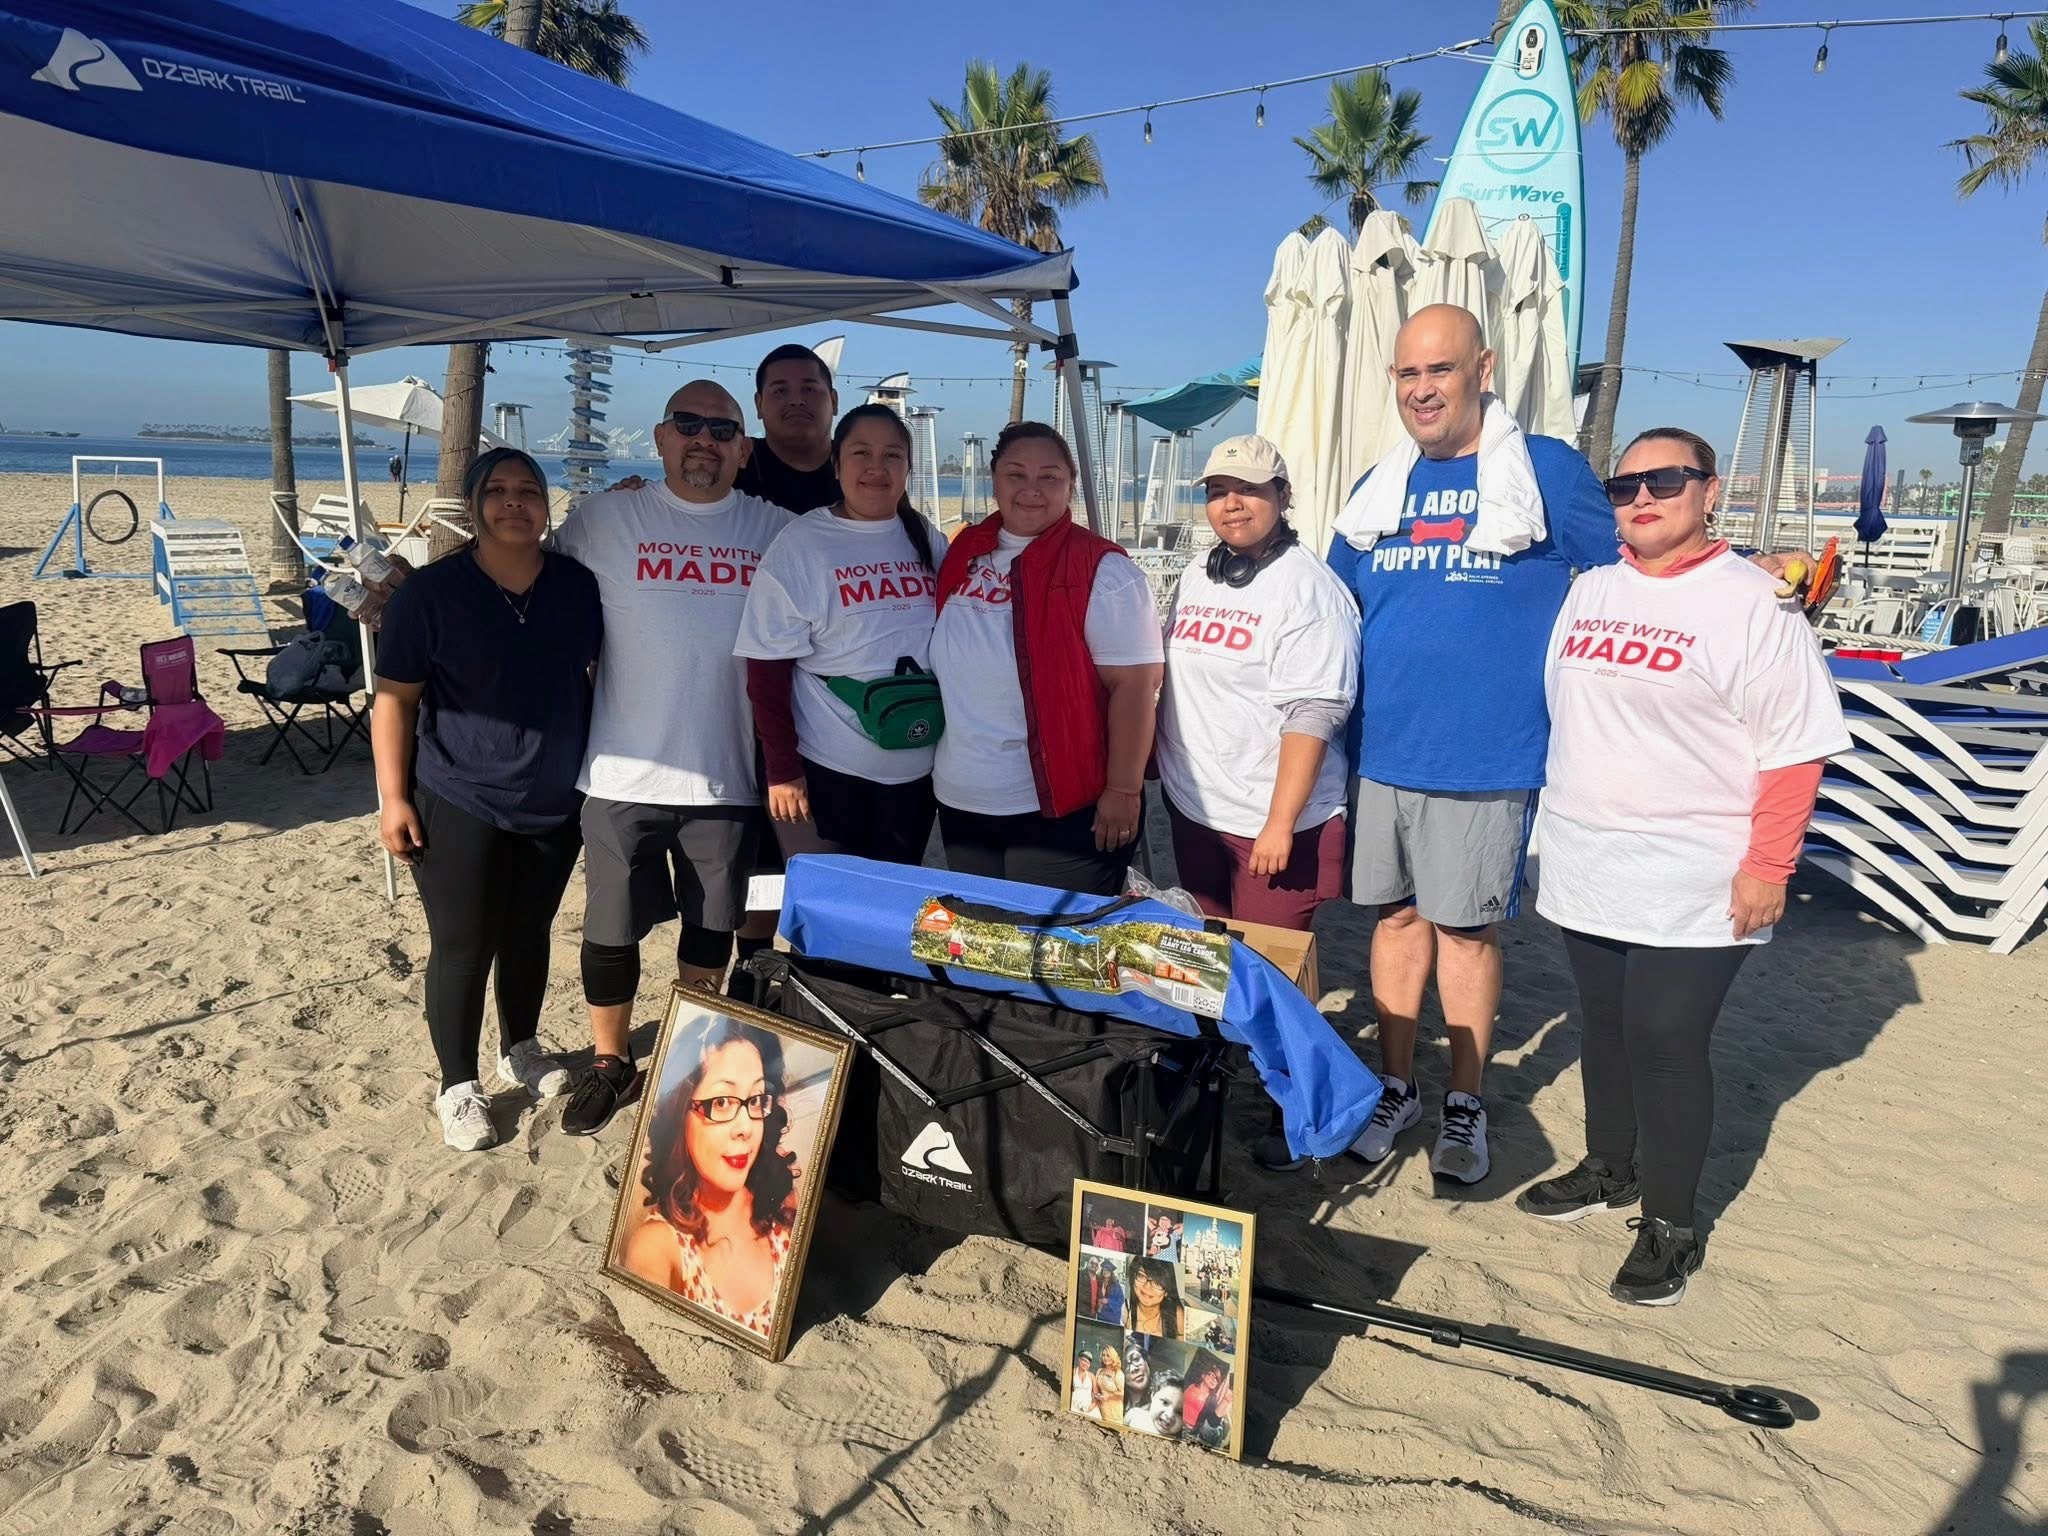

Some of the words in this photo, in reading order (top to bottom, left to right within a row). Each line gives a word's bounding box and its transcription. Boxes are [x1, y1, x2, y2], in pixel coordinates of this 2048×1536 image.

[1480, 108, 1557, 148] SW
[1459, 183, 1565, 203] SurfWave
[1421, 489, 1478, 517] ABO
[638, 542, 703, 557] MOVE
[709, 546, 762, 562] WITH
[1371, 545, 1441, 573] PUPPY
[1446, 544, 1502, 570] PLAY
[835, 561, 892, 581] MOVE
[691, 588, 716, 596] 2025
[892, 604, 911, 612] 2025
[1178, 604, 1215, 618] MOVE
[1215, 607, 1262, 627] WITH
[1169, 619, 1253, 651] MADD
[1571, 619, 1630, 634] MOVE
[1632, 623, 1696, 648] WITH
[1559, 635, 1683, 672] MADD
[1594, 668, 1618, 678] 2025
